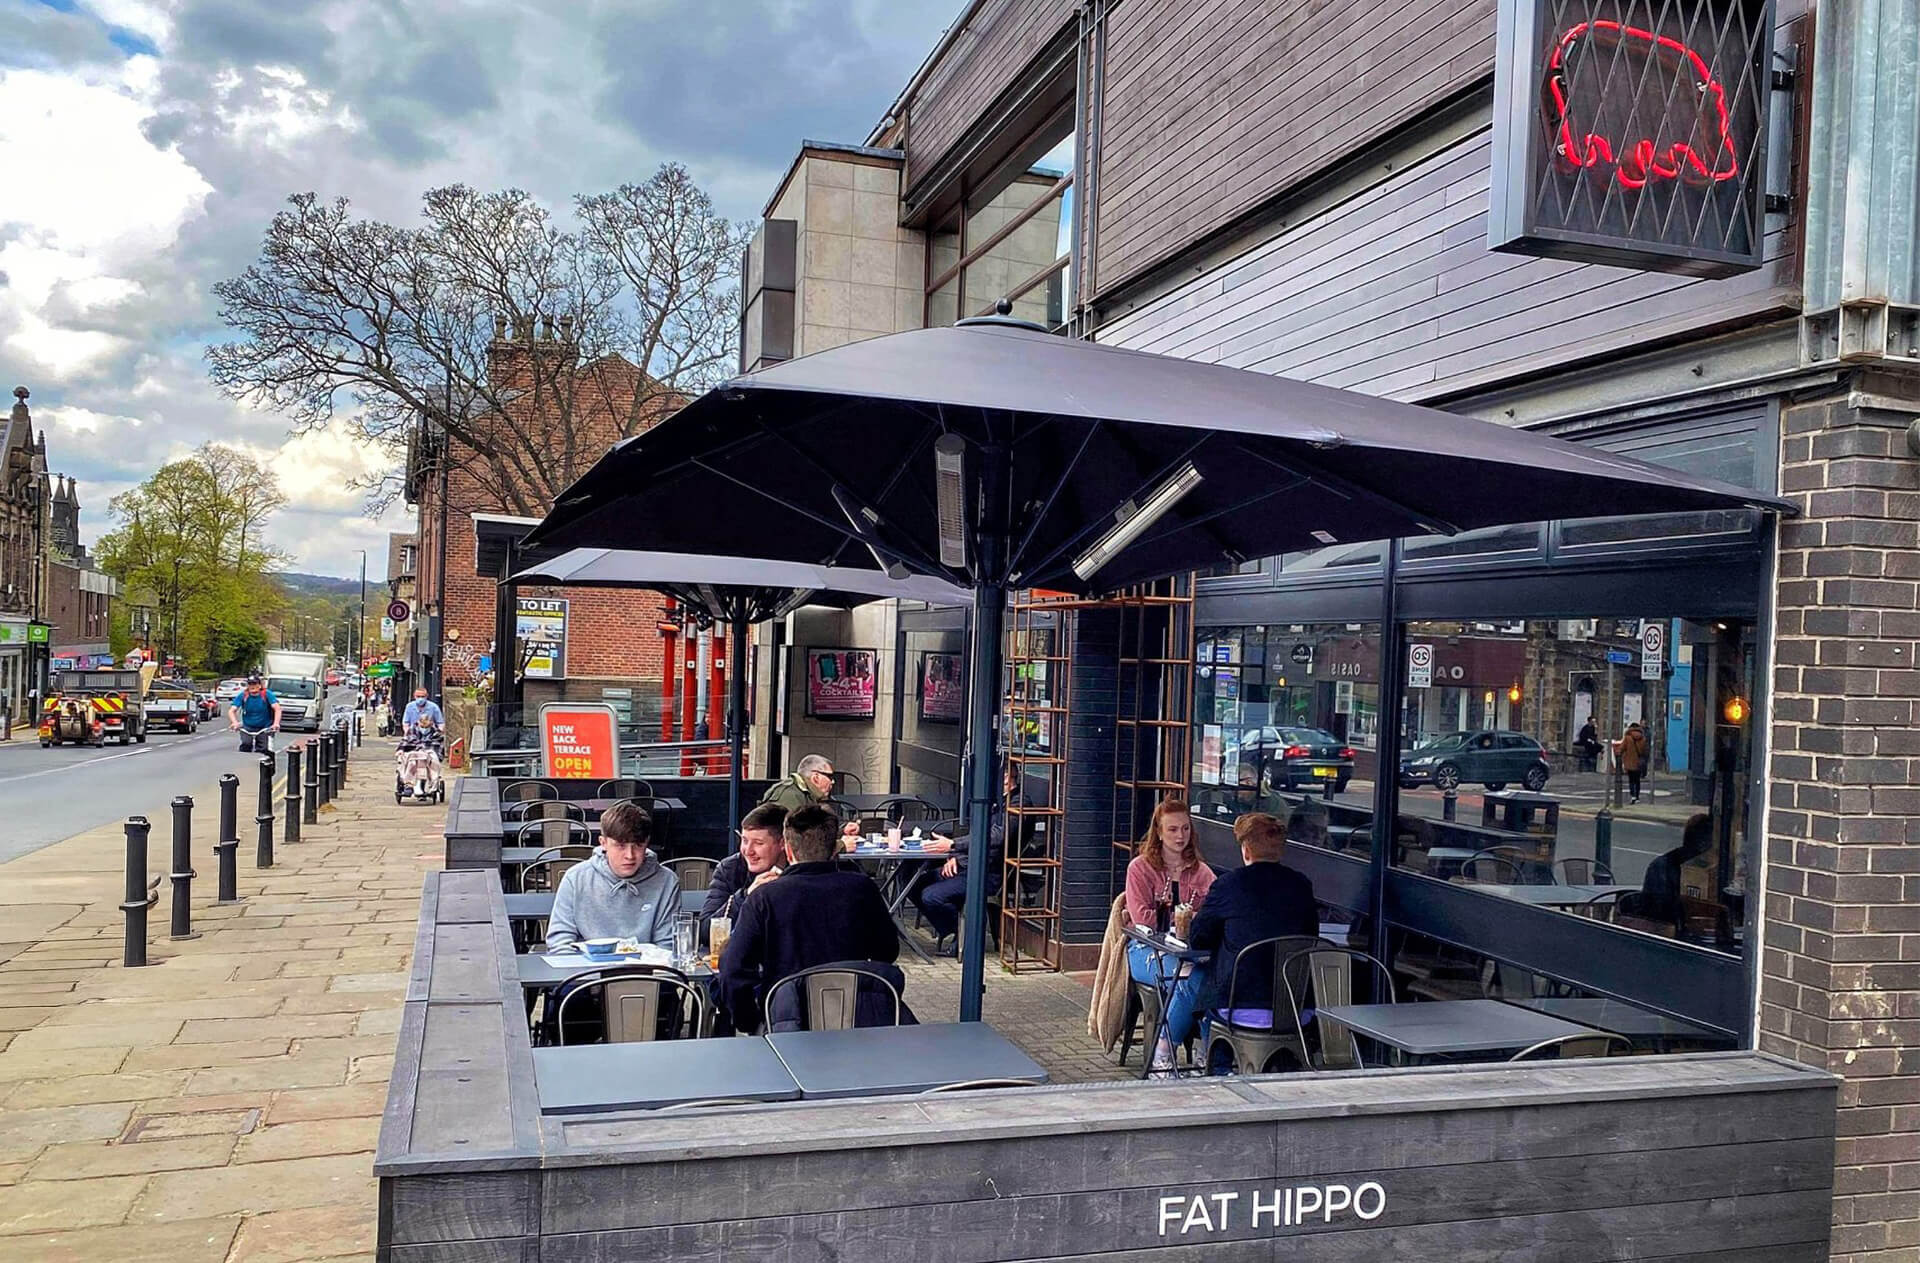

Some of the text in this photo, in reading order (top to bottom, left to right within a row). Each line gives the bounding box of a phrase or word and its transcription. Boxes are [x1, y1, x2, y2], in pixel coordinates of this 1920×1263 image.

[520, 600, 561, 611] TO LET
[822, 677, 863, 690] 2-4-1
[552, 725, 574, 734] NEW
[553, 735, 576, 744] BACK
[554, 745, 591, 754] TERRACE
[555, 757, 592, 770] OPEN
[1158, 1182, 1387, 1236] FAT HIPPO
